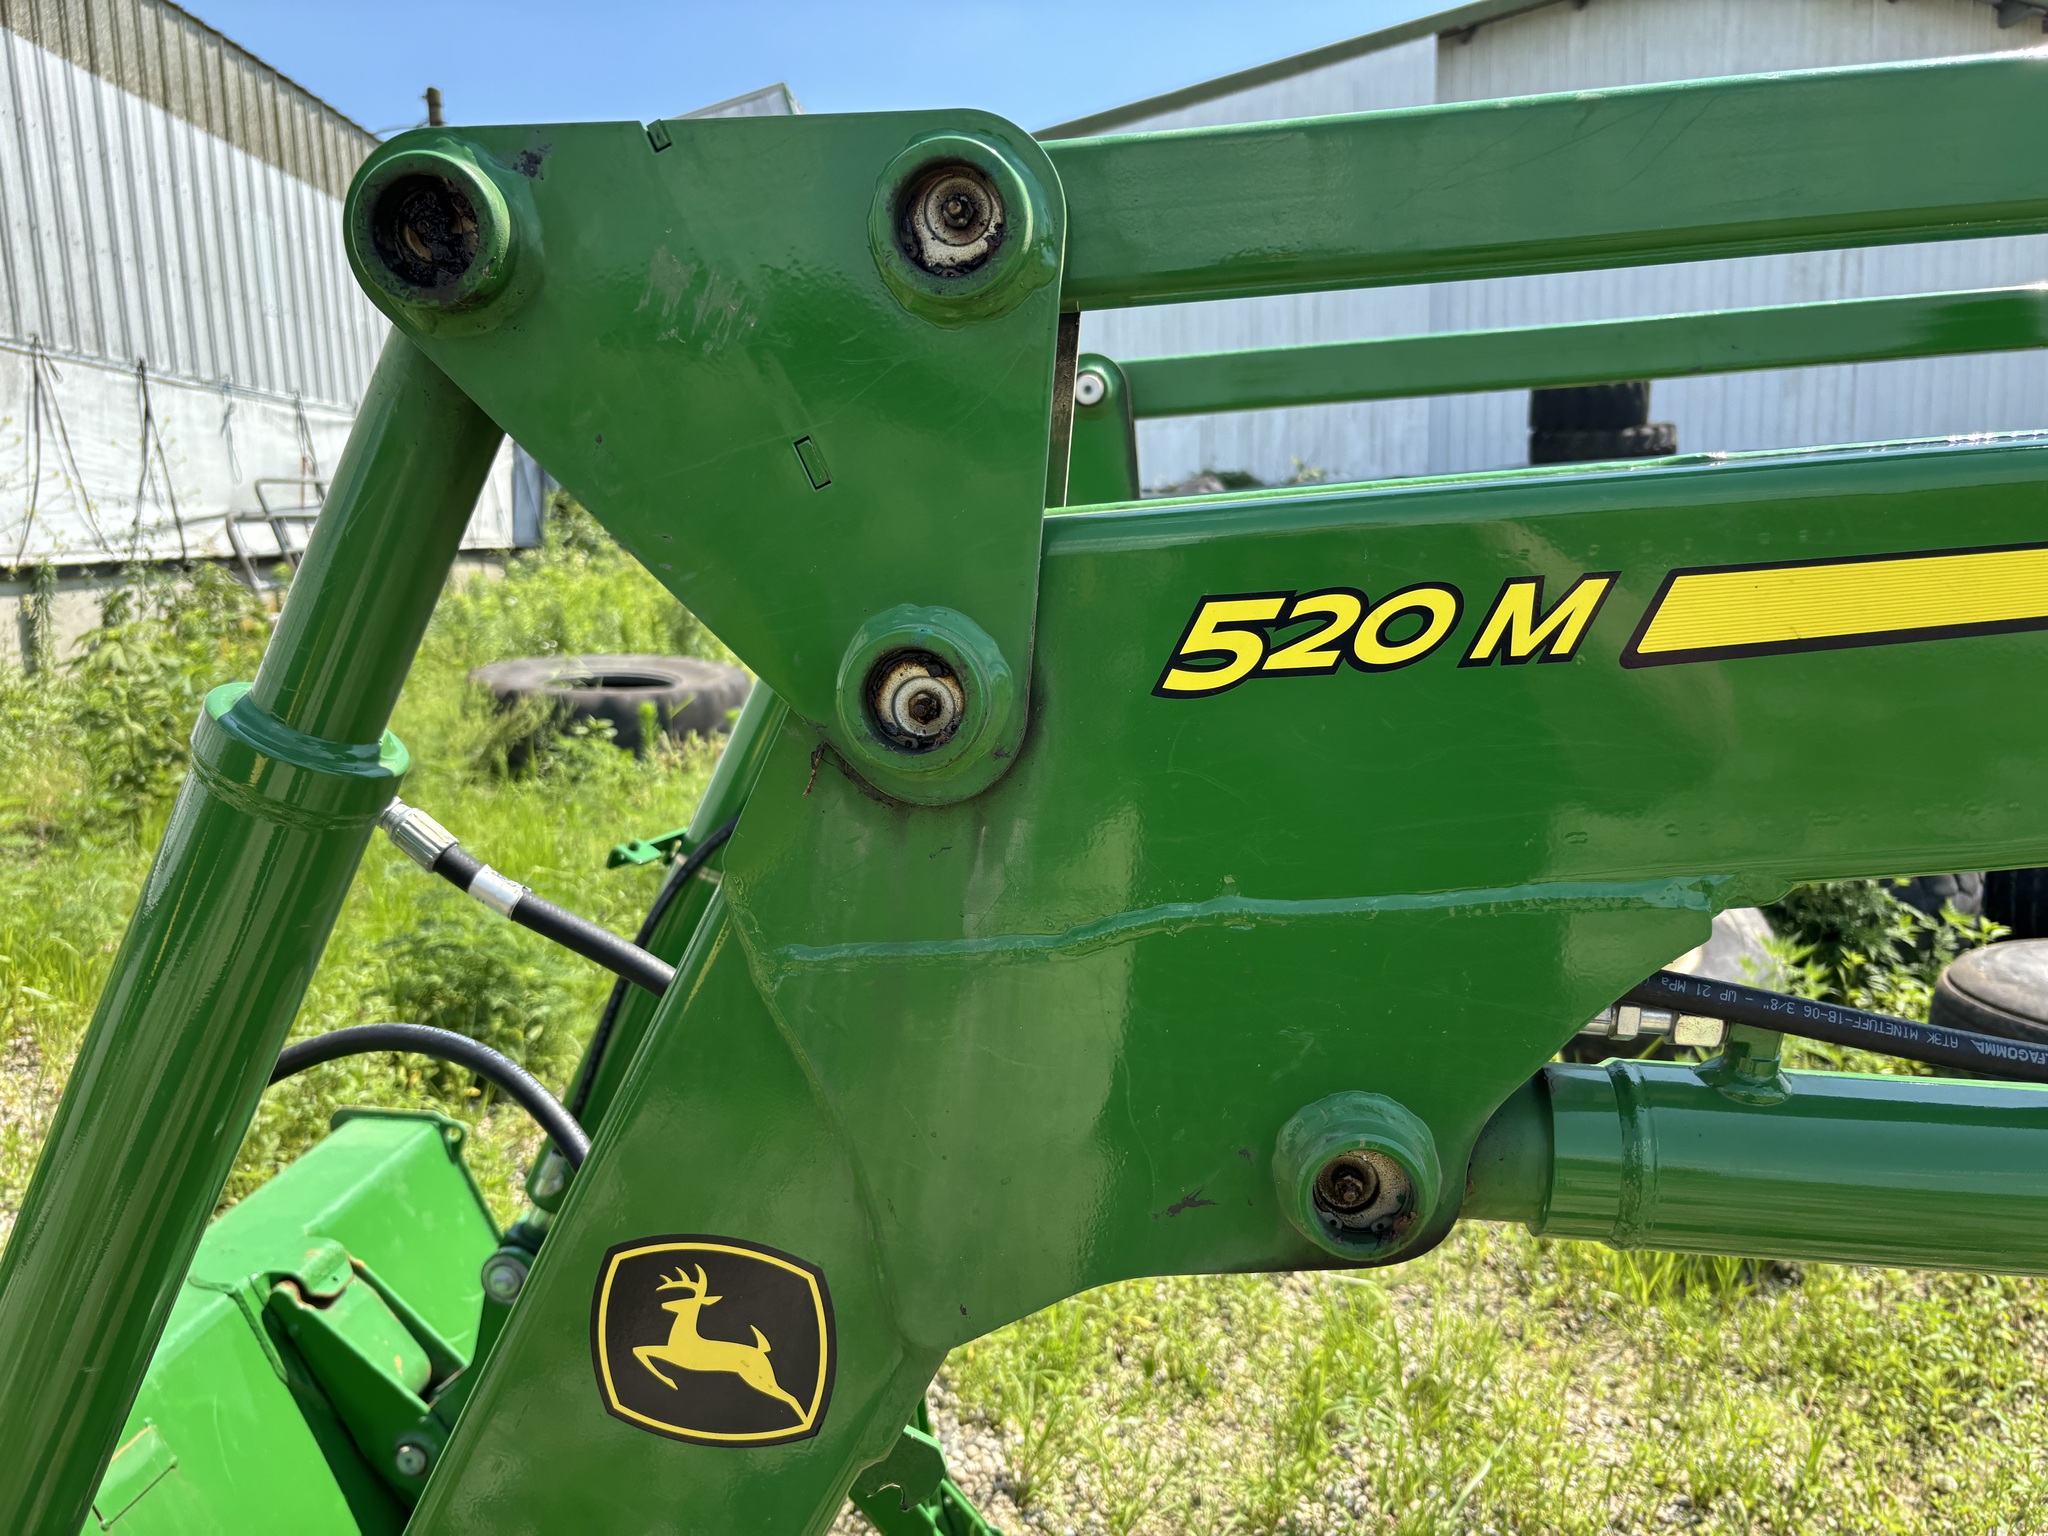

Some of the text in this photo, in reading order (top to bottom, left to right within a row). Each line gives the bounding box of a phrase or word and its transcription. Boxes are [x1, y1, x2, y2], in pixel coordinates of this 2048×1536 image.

[1154, 574, 1616, 697] 520 M
[1661, 976, 1687, 993] MPa
[1696, 983, 1711, 998] 21
[1970, 1039, 2048, 1065] FAGOMMA
